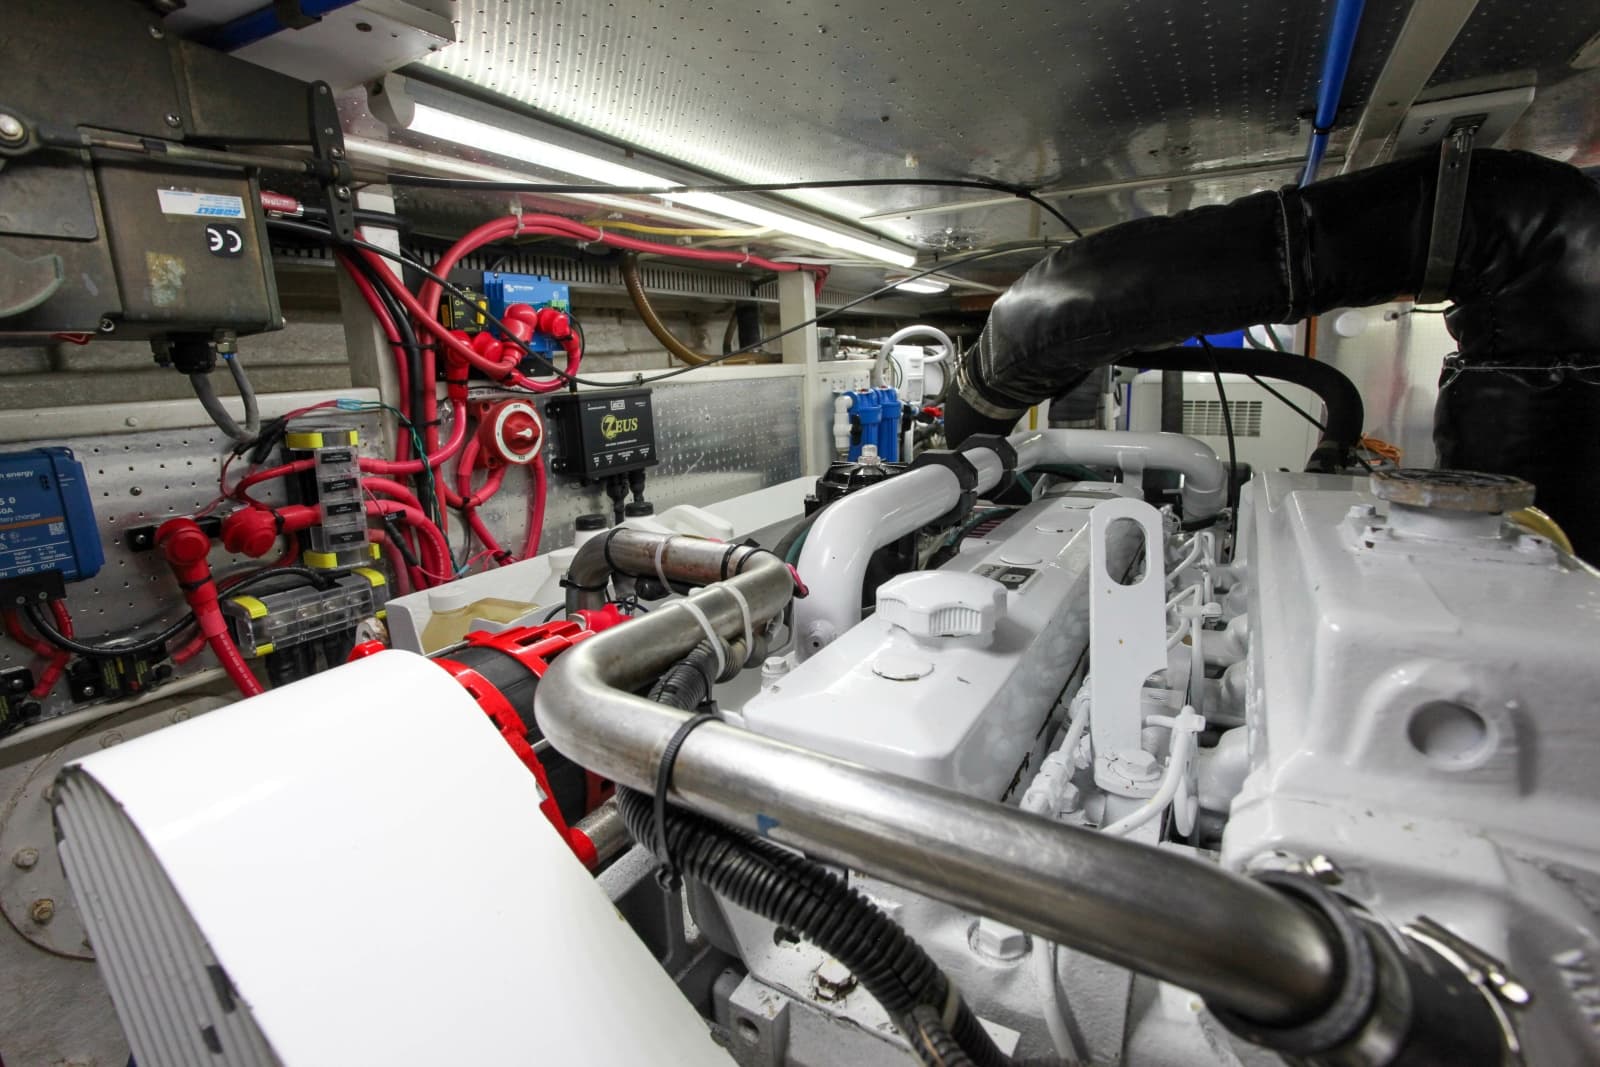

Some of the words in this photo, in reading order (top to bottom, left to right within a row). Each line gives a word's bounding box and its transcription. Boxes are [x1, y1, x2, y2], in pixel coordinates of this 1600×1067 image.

[601, 414, 638, 439] ZEUS
[6, 470, 34, 479] energy
[0, 507, 14, 515] 0A
[40, 562, 56, 571] OUT
